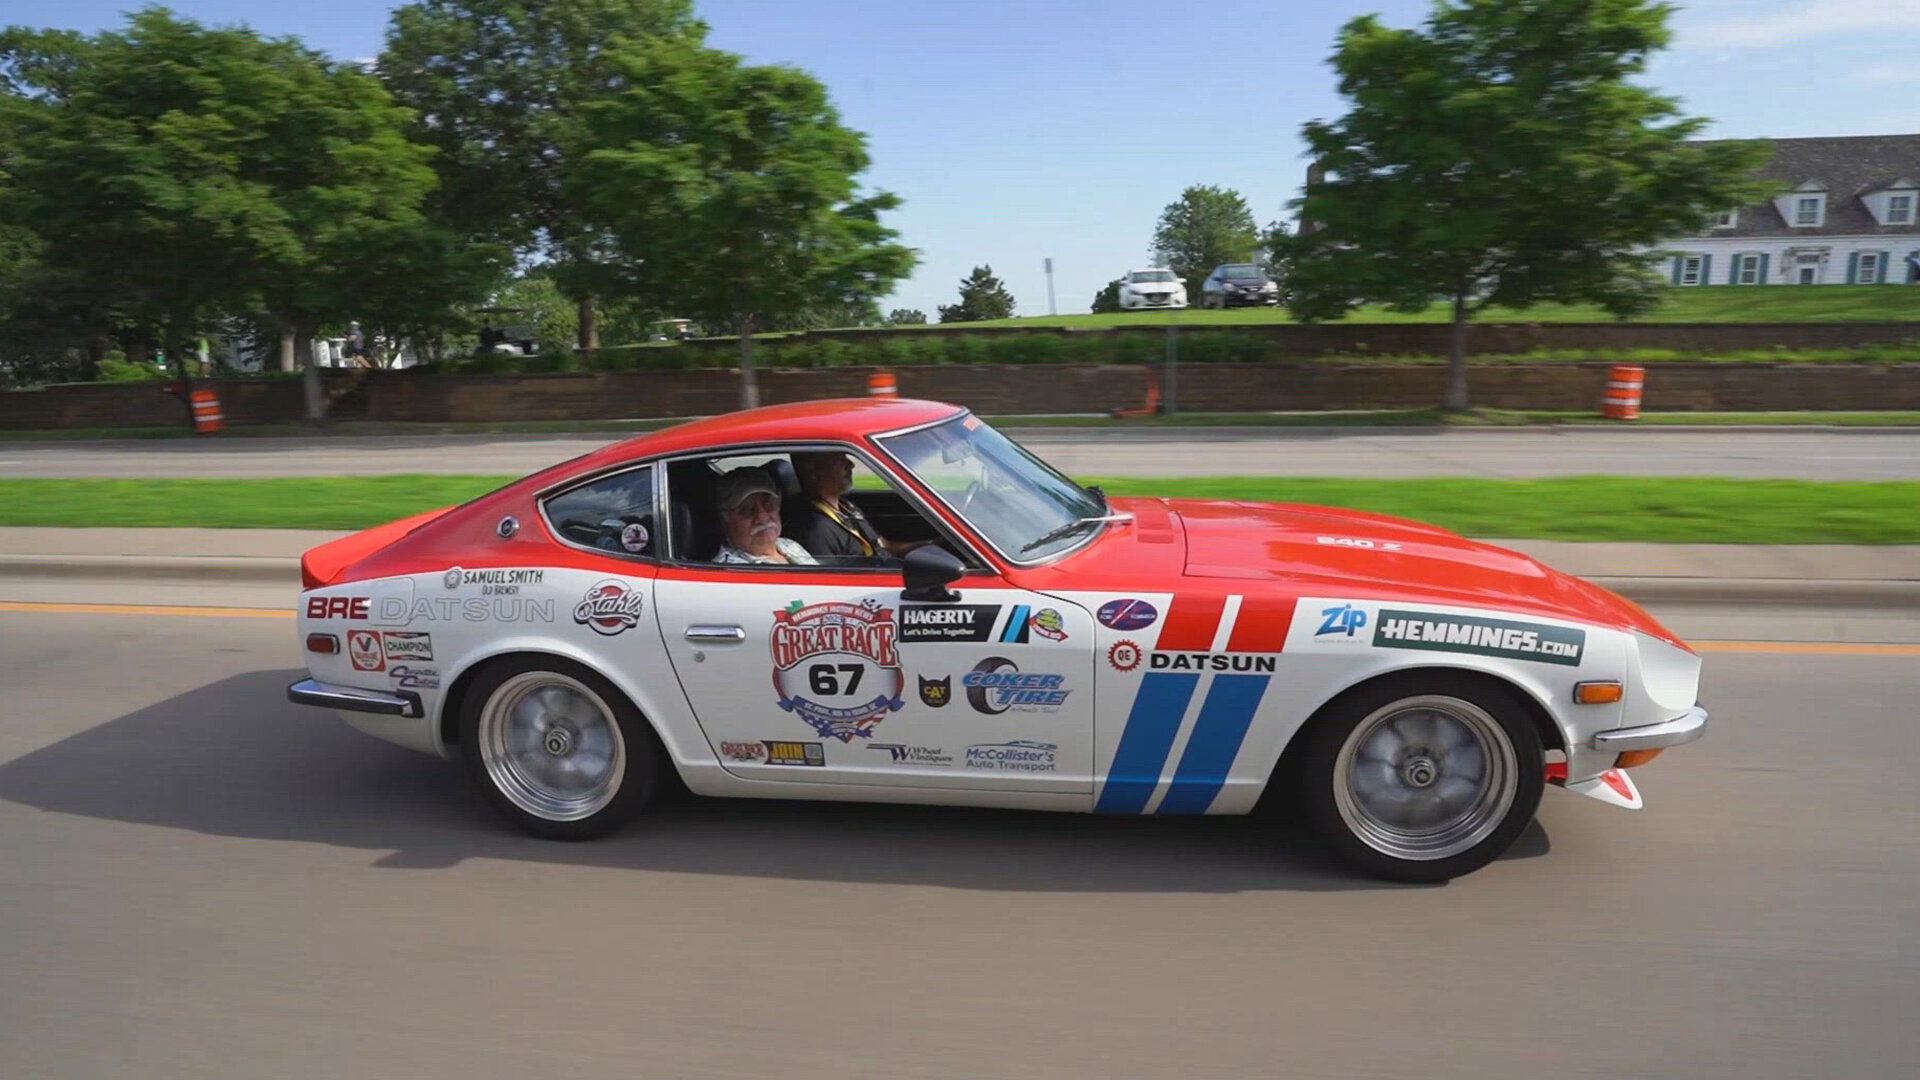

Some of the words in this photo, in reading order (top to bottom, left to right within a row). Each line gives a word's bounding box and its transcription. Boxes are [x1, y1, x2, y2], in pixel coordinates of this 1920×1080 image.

[1316, 536, 1375, 548] 240
[464, 570, 505, 584] SAMUEL
[509, 570, 544, 583] SMITH
[306, 597, 371, 619] BRE
[379, 597, 555, 622] DATSUN
[903, 609, 975, 624] HAGERTY
[1314, 603, 1367, 637] Zip
[903, 628, 921, 636] Let's
[922, 628, 942, 636] Drive
[943, 628, 975, 637] Together
[1380, 618, 1579, 658] HEMMINGS.COM
[387, 641, 430, 652] CHAMPION
[772, 624, 838, 667] GREAT
[841, 624, 897, 667] RACE
[1150, 653, 1276, 672] DATSUN
[809, 664, 865, 696] 67
[962, 671, 1065, 689] COKER
[923, 685, 946, 699] CAT
[996, 689, 1070, 706] TIRE
[966, 748, 1055, 762] McCollister's
[966, 760, 994, 769] Auto
[999, 761, 1056, 772] Transport
